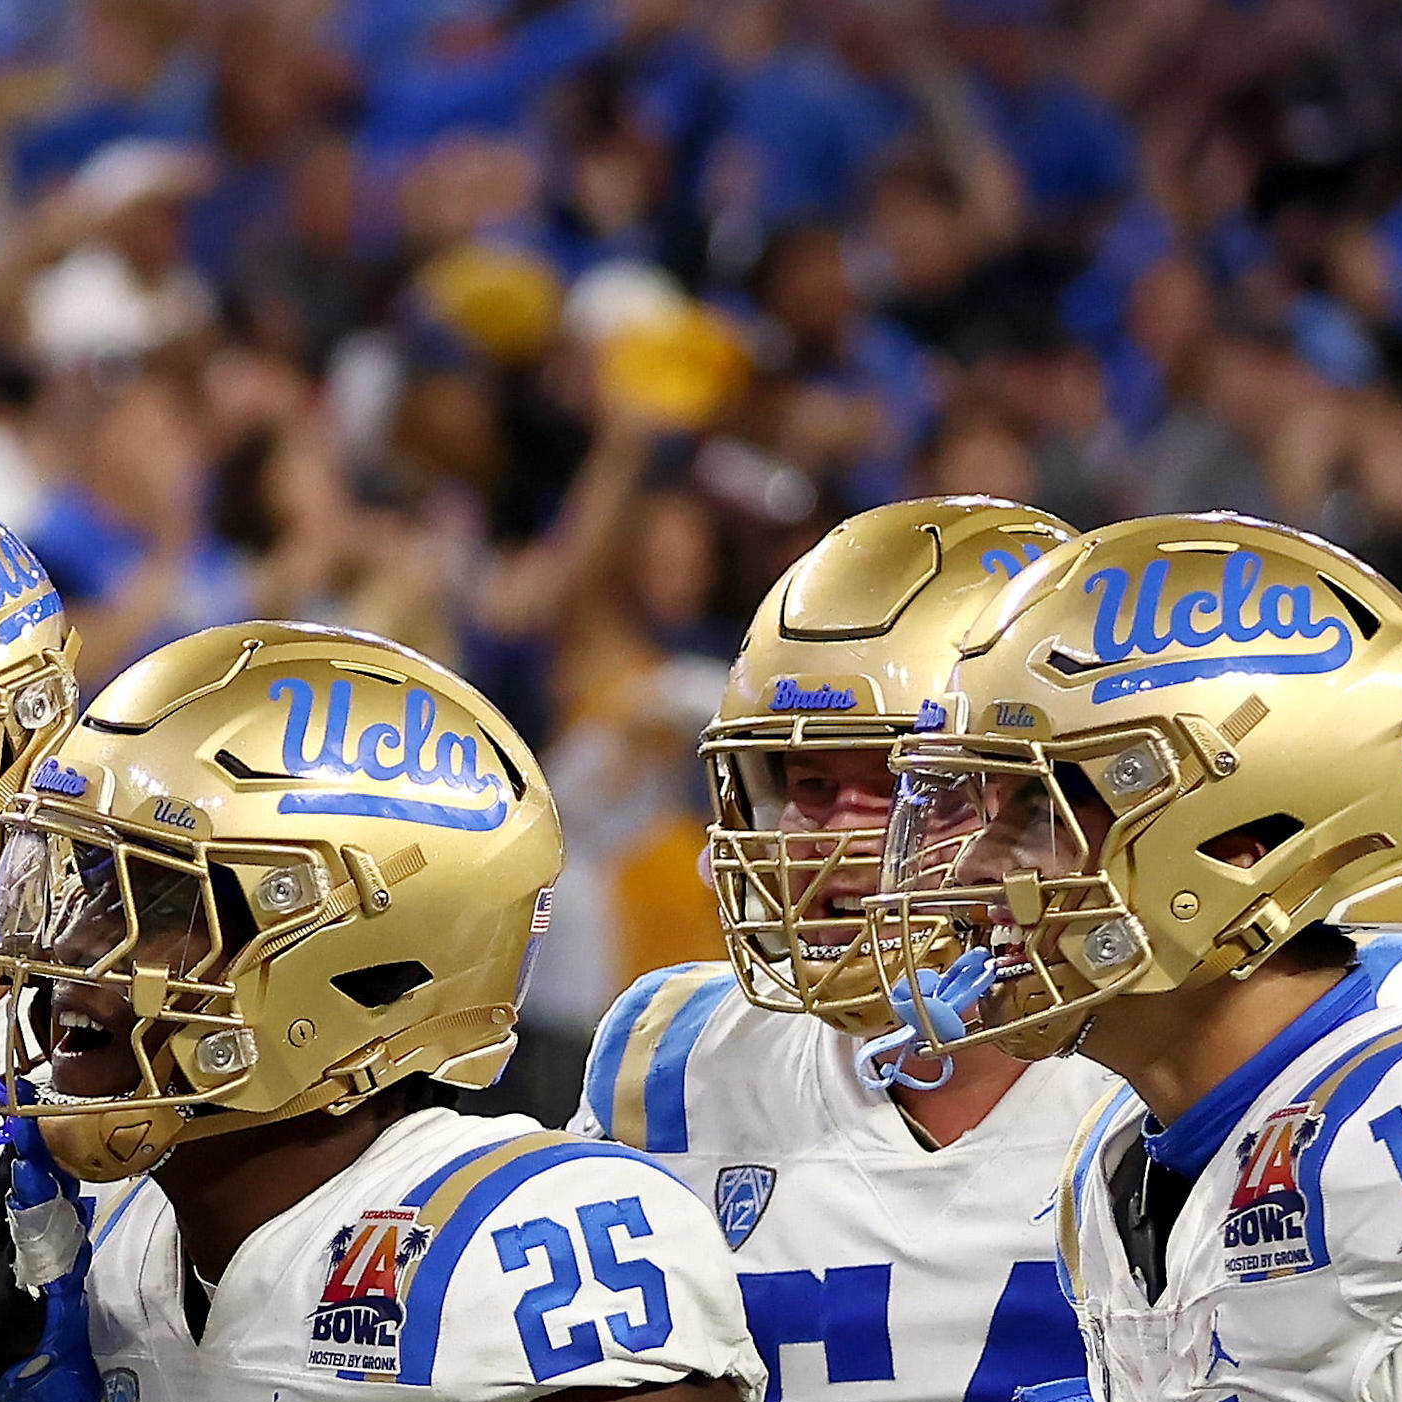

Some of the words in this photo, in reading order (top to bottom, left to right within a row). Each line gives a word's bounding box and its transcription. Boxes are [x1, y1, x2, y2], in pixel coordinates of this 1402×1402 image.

[1083, 550, 1343, 664] Ucla
[768, 678, 857, 711] Bruins
[269, 678, 490, 793] Ucla
[154, 799, 197, 830] Ucla
[1229, 1120, 1298, 1211] LA
[725, 1199, 756, 1232] 12
[1224, 1206, 1304, 1249] BOWL
[319, 1224, 399, 1304] LA
[1224, 1257, 1259, 1274] HOSTED
[1258, 1253, 1273, 1271] BY
[490, 1195, 674, 1385] 25
[311, 1307, 397, 1348] BOWL
[308, 1350, 346, 1367] HOSTED
[347, 1353, 362, 1368] BY
[361, 1355, 398, 1372] GRONK
